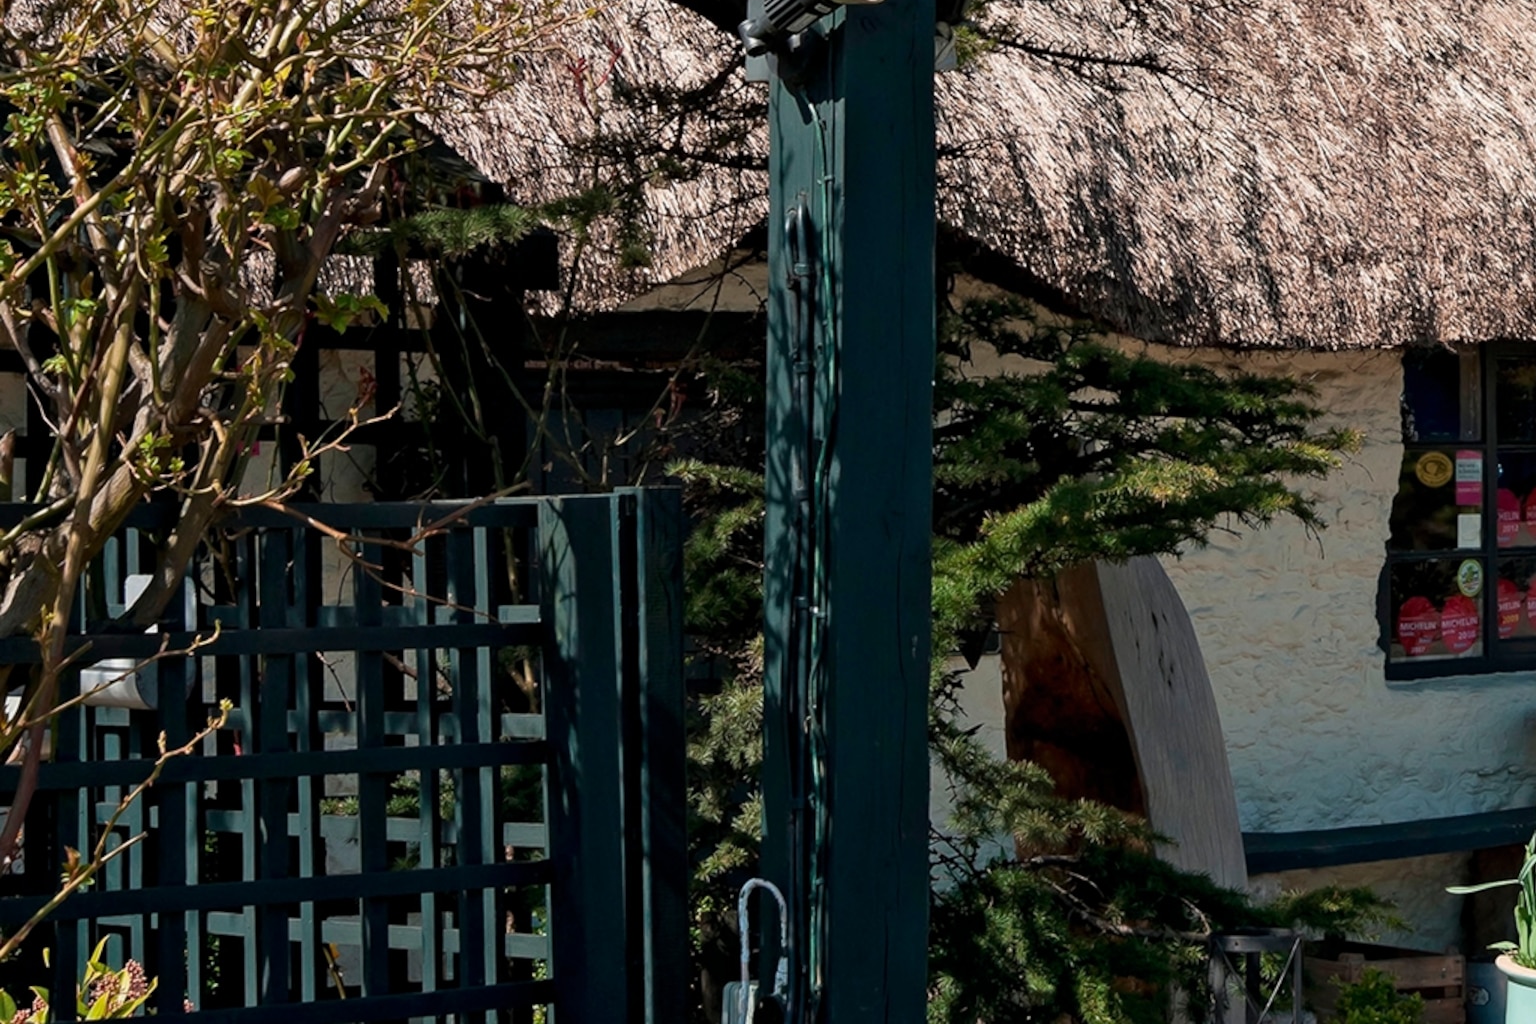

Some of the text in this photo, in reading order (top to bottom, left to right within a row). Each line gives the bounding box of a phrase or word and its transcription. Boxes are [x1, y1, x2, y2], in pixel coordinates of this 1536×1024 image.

[1498, 511, 1520, 521] HELIN
[1498, 601, 1520, 612] HELIN
[1400, 621, 1437, 630] MICHELIN
[1441, 617, 1479, 629] MICHELIN
